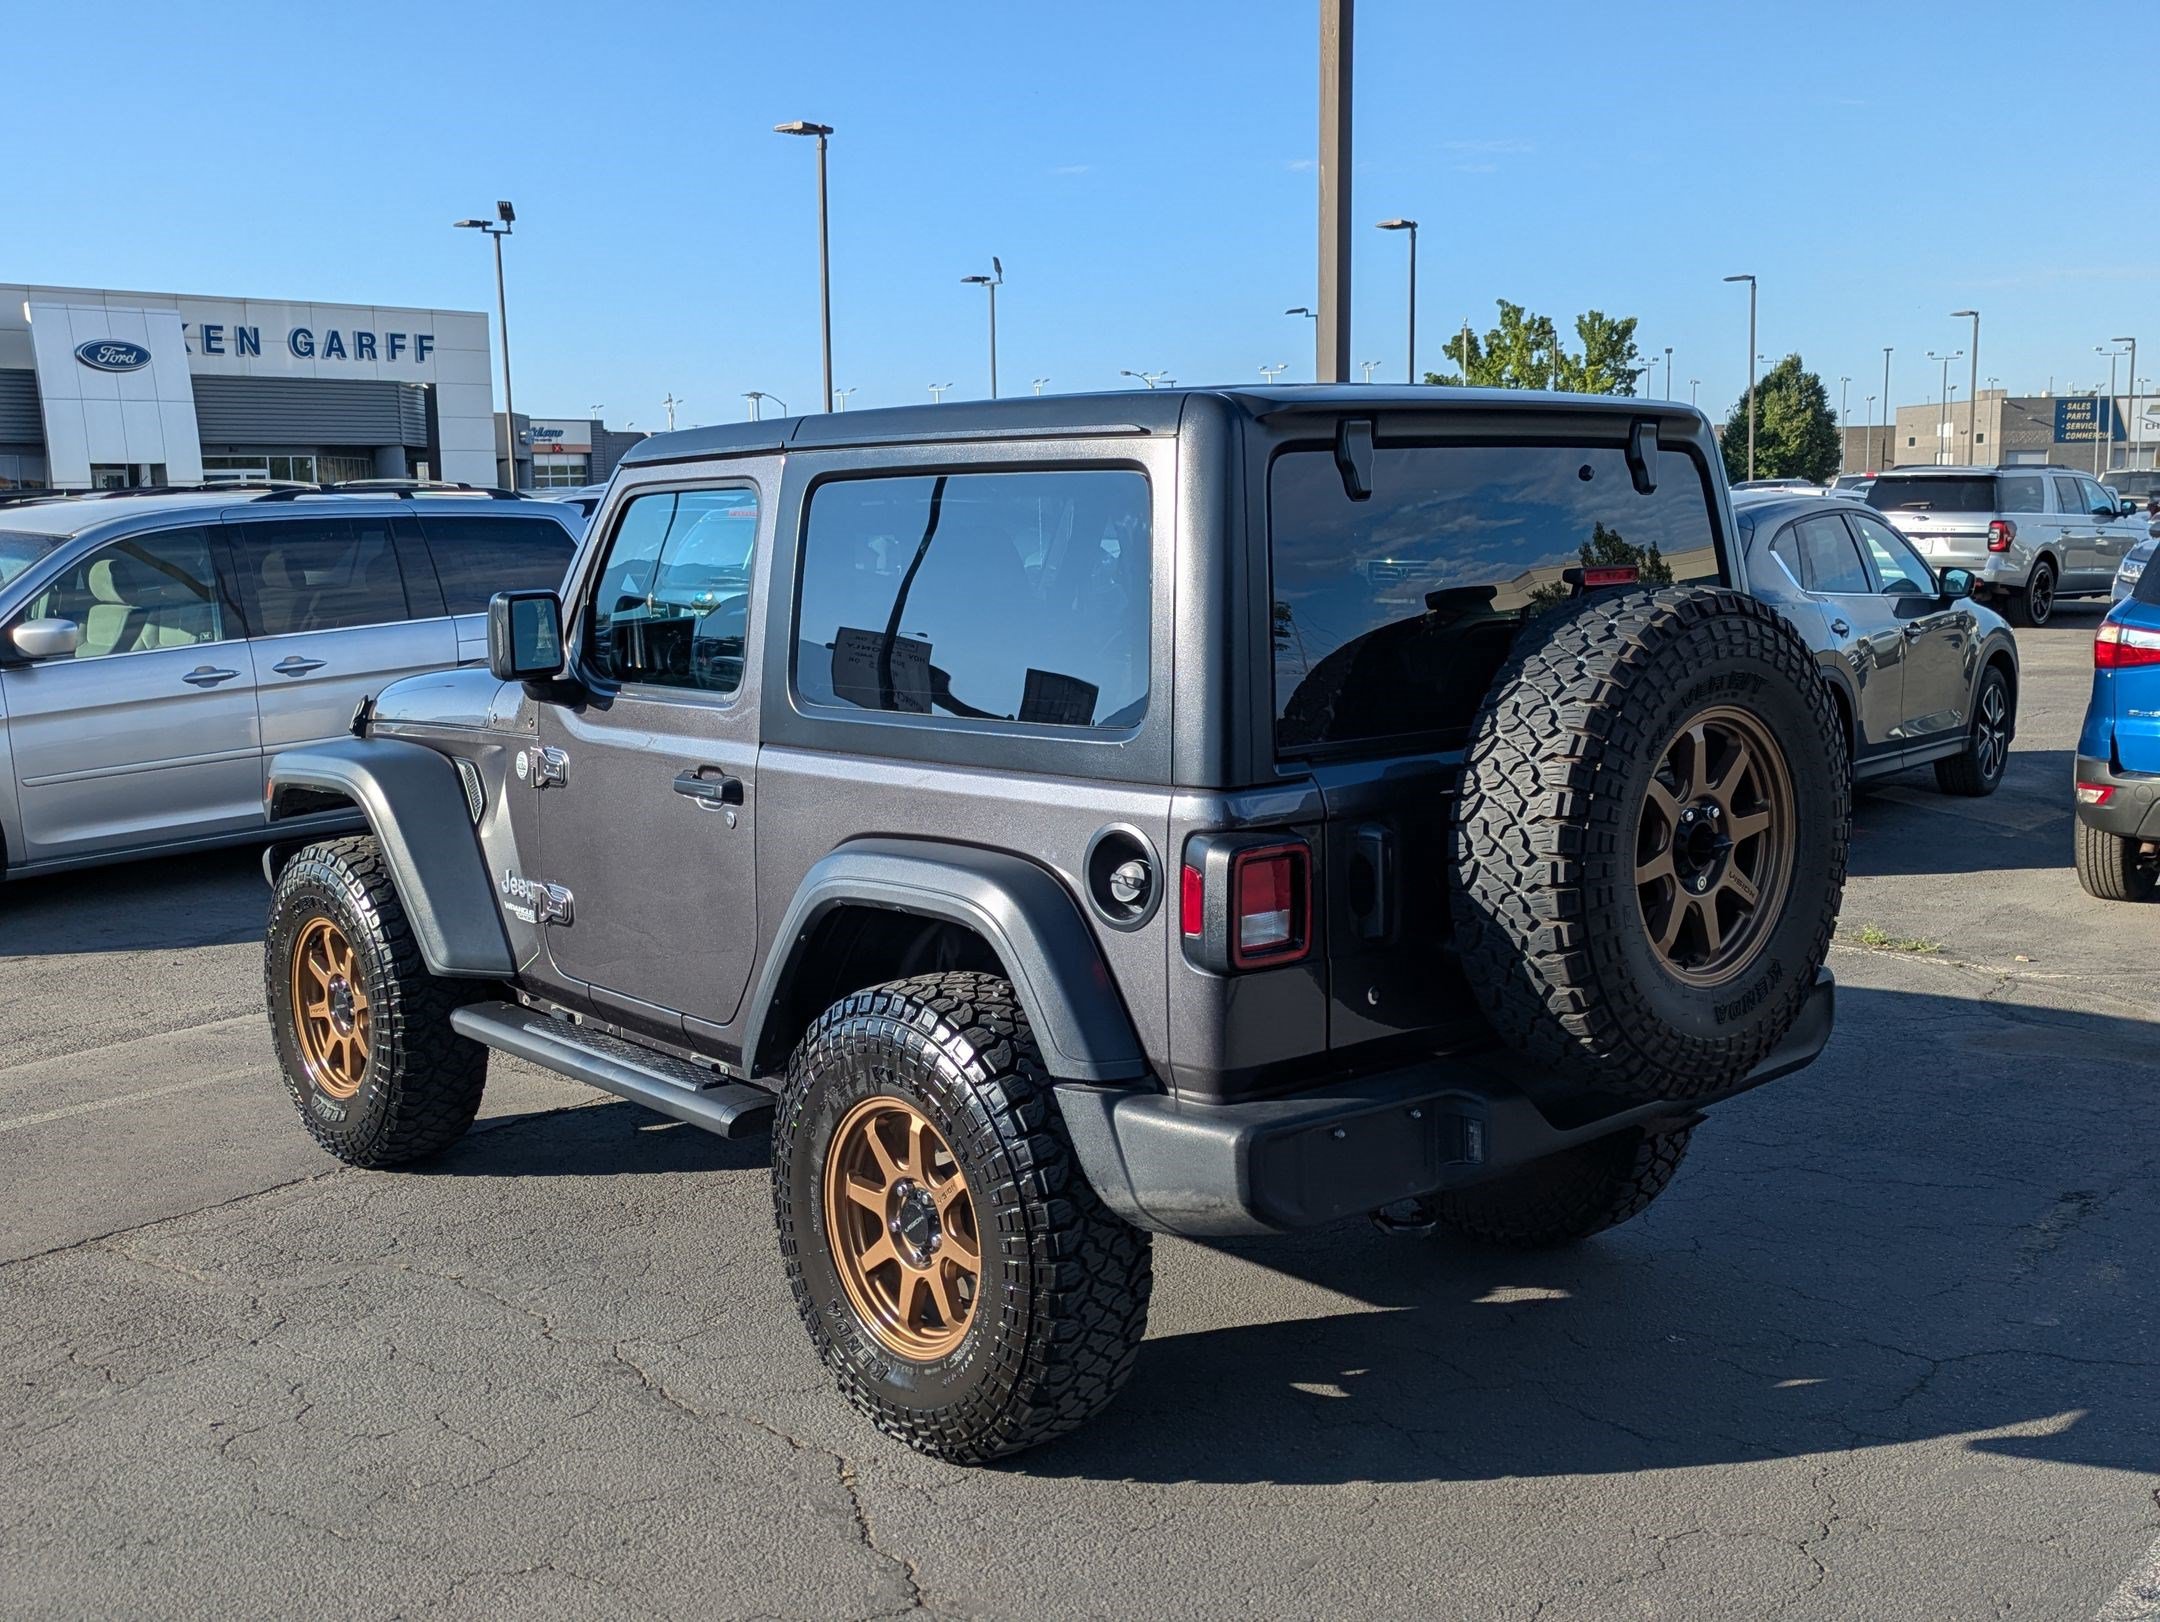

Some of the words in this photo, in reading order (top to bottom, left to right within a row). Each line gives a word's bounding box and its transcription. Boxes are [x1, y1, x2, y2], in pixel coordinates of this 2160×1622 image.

[97, 345, 137, 364] Ford
[289, 328, 435, 363] GARFF
[2065, 412, 2091, 420] PARTS
[2066, 402, 2091, 410] SALES
[2065, 422, 2097, 430] SERVICE
[501, 869, 535, 905] Jeep
[1728, 870, 1756, 899] VISION
[1714, 958, 1783, 1025] KENDA
[825, 1299, 891, 1382] KENDA
